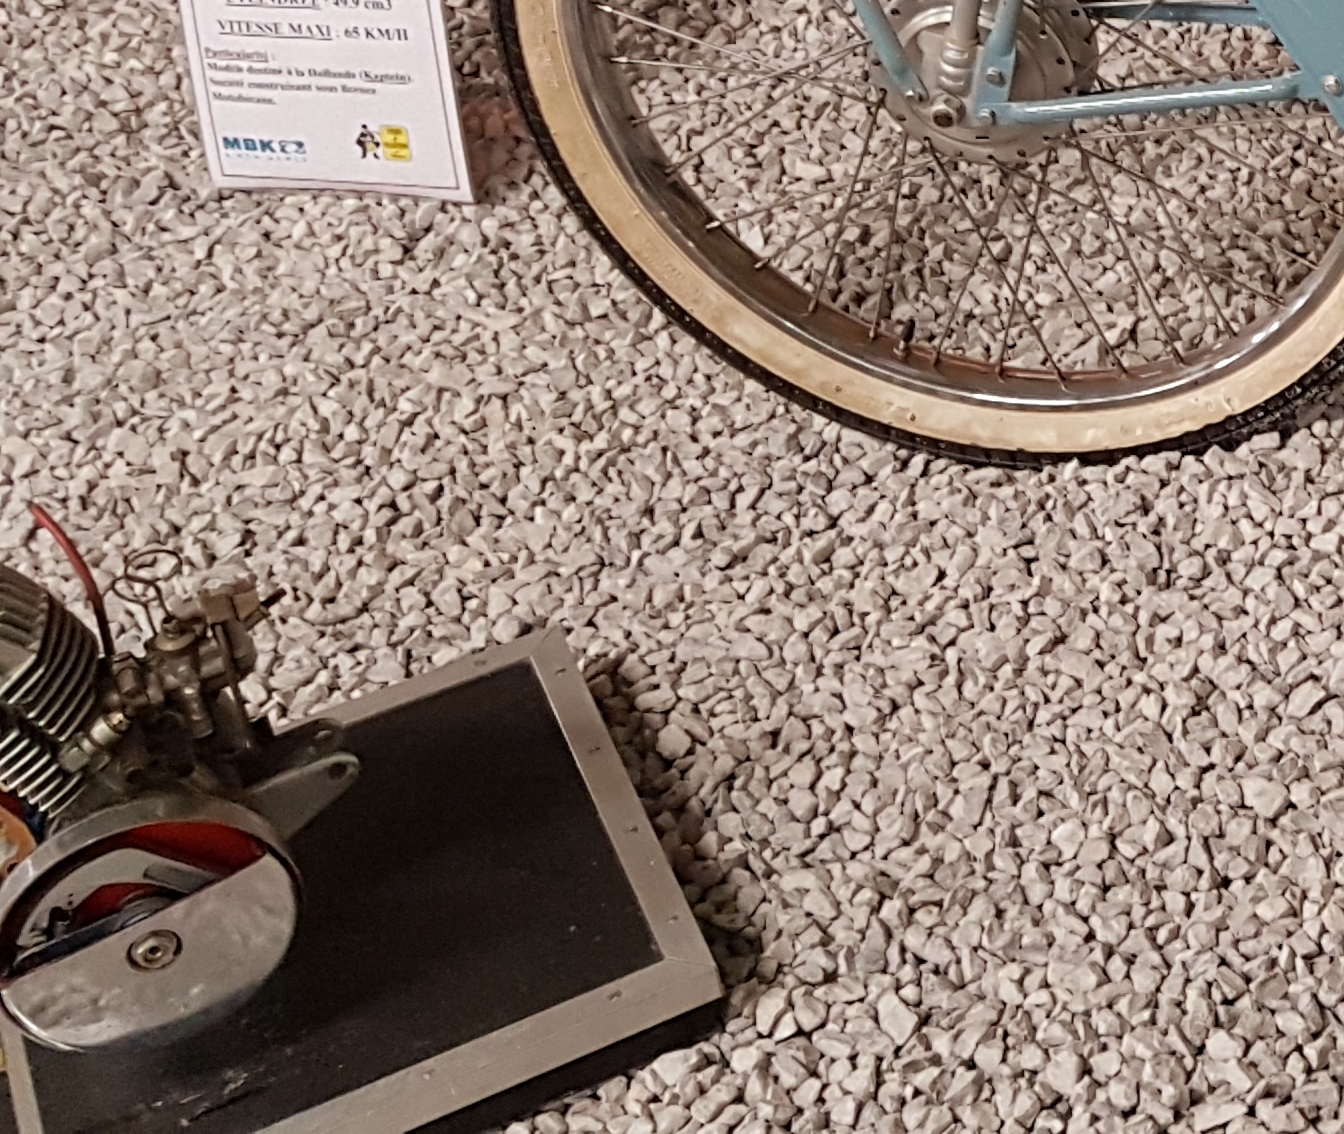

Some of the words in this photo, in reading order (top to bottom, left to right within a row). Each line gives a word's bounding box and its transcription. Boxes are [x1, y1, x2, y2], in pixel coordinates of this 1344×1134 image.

[217, 20, 282, 36] VITESSE
[288, 23, 332, 39] MAXI
[344, 27, 359, 39] 65
[365, 27, 409, 41] KM/H
[223, 137, 276, 153] MBK
